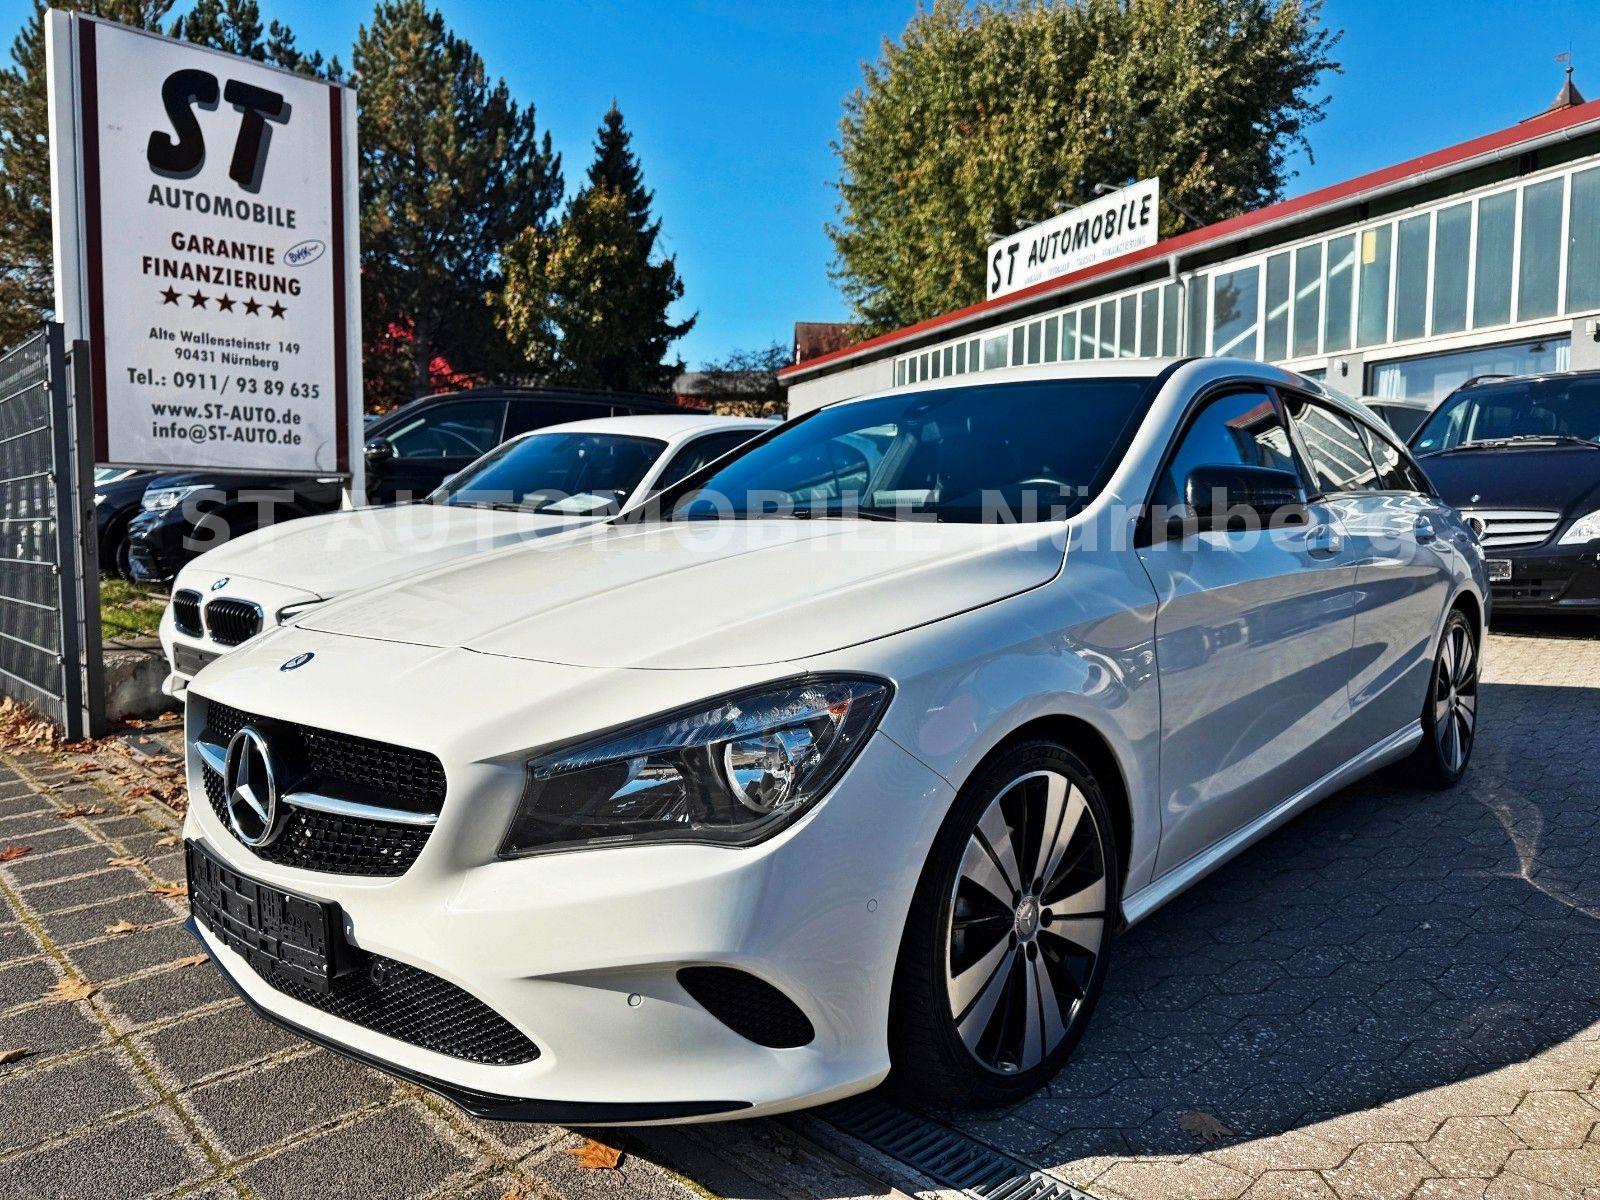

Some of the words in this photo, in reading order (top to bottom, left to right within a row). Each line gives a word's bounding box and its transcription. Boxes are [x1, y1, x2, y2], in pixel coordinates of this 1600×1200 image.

[147, 69, 292, 194] ST
[148, 184, 296, 229] AUTOMOBILE
[171, 231, 275, 265] GARANTIE
[991, 242, 1020, 293] ST
[1028, 193, 1152, 268] AUTOMOBILE
[142, 256, 301, 296] FINANZIERUNG
[149, 327, 175, 341] Alte
[180, 330, 271, 351] Wallensteinstr
[279, 341, 300, 354] 149
[175, 347, 215, 362] 90431
[221, 352, 279, 371] Nürnberg
[127, 367, 166, 386] Tel.:
[173, 371, 230, 395] 0911/
[236, 377, 257, 394] 93
[264, 380, 284, 396] 89
[290, 382, 320, 399] 635
[152, 403, 301, 425] www.ST-AUTO.de
[152, 421, 301, 445] info@ST-AUTO.de
